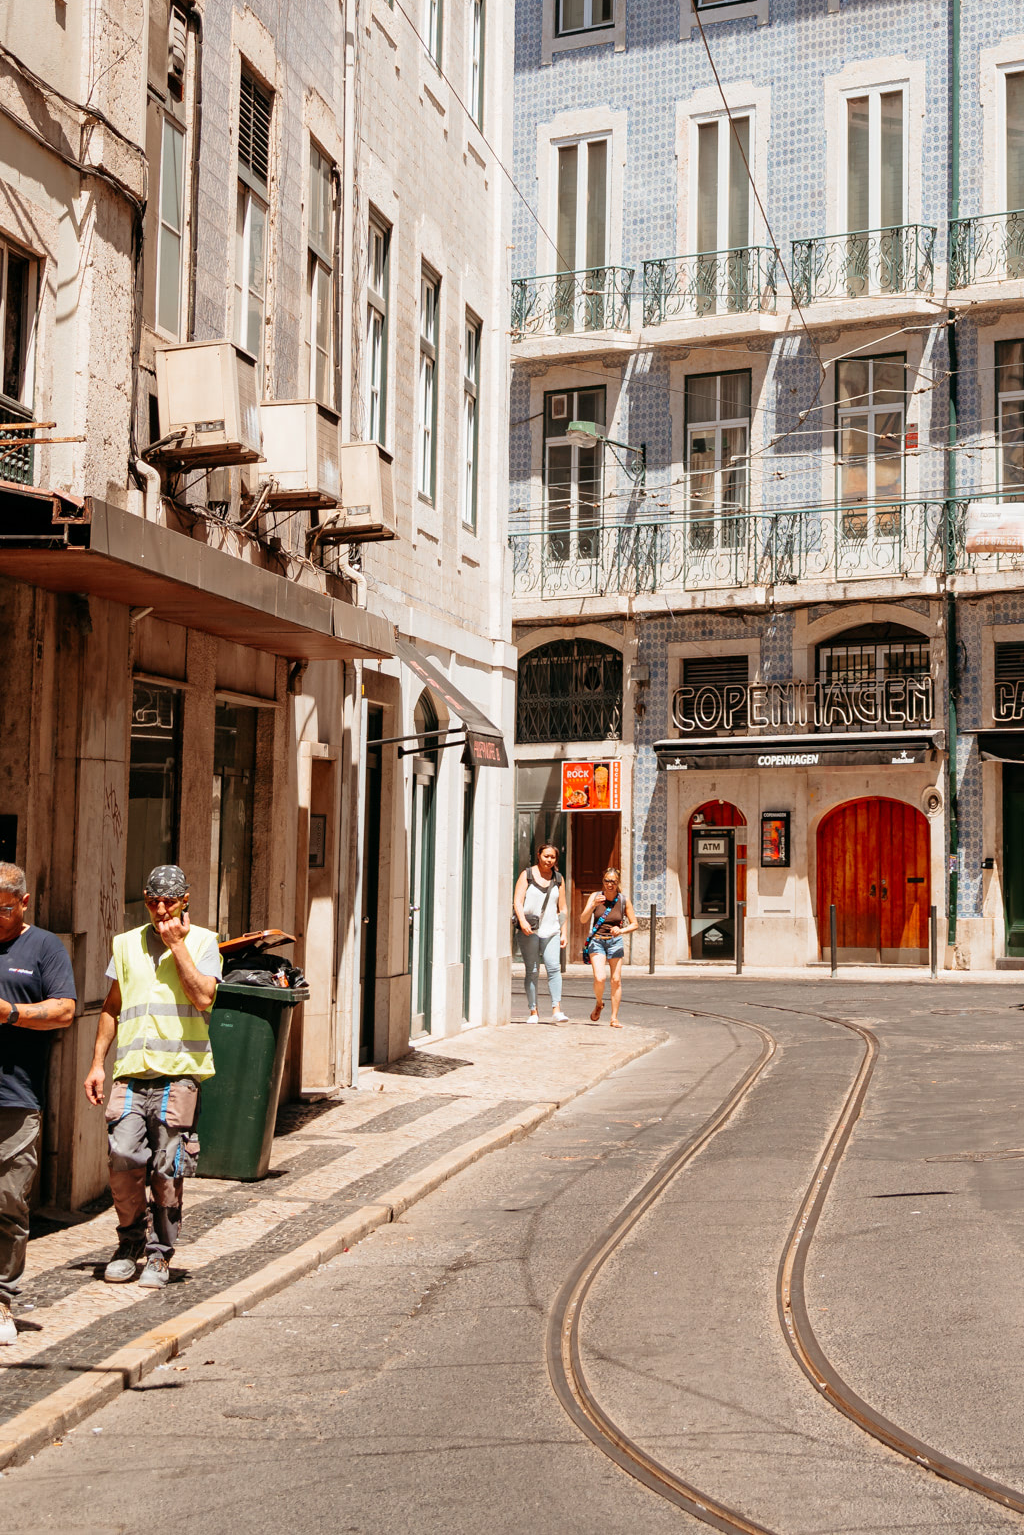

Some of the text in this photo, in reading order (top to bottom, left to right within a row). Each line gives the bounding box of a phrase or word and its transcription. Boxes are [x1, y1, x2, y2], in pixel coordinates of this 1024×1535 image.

[671, 676, 932, 731] COPENHAGEN
[758, 754, 819, 766] COPENHAGEN
[566, 770, 589, 778] ROCK
[702, 843, 721, 851] ATM
